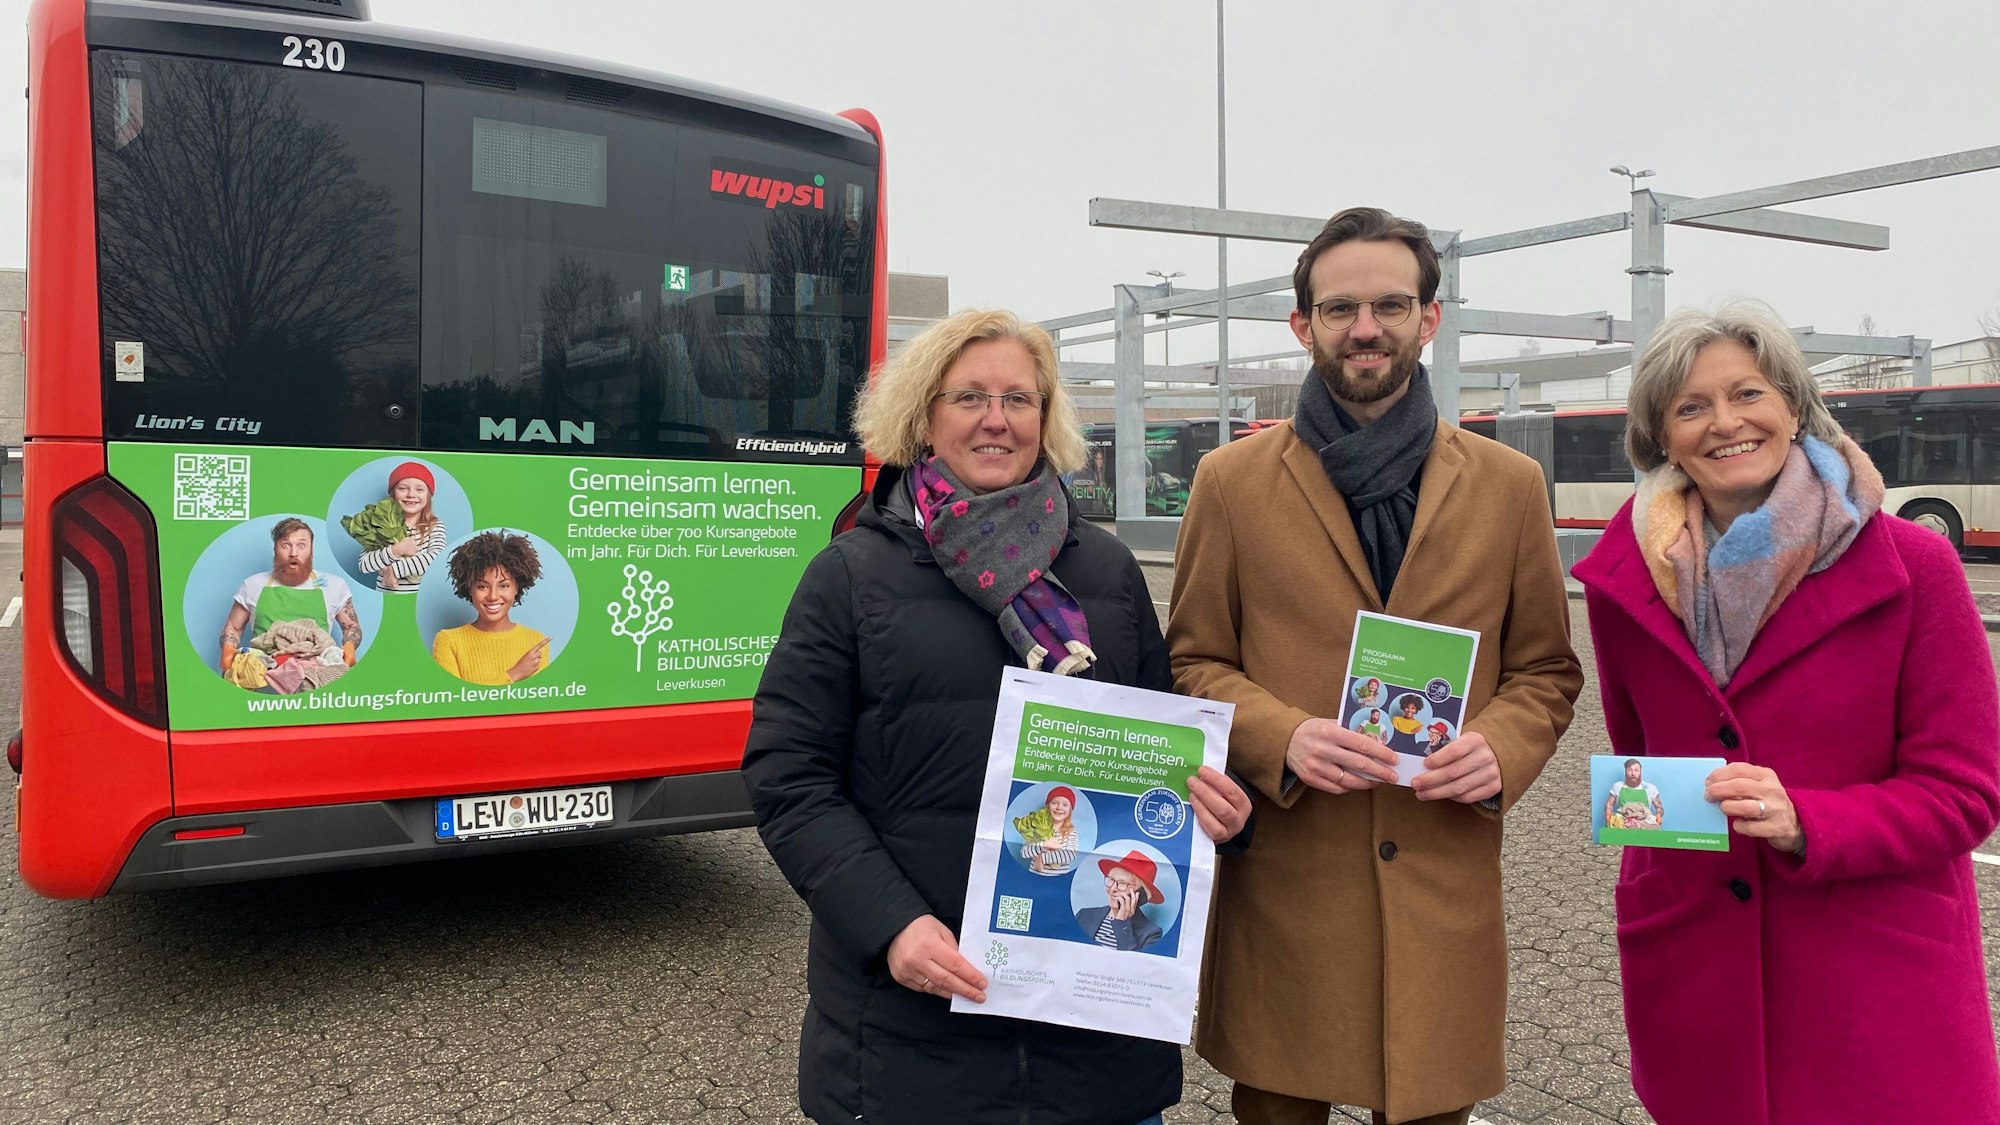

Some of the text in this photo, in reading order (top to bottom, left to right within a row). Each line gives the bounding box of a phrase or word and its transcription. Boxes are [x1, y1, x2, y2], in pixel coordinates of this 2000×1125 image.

[282, 35, 346, 72] 230
[711, 169, 825, 210] wupsi
[135, 414, 262, 435] Lion's City
[479, 416, 595, 445] MAN
[735, 437, 847, 455] EfficientHybrid
[569, 467, 797, 495] Gemeinsam lernen.
[568, 494, 822, 520] Gemeinsam wachsen.
[567, 523, 797, 541] Entdecke über 700 Kursangebote
[567, 544, 799, 561] im Jahr. Für Dich. Für Leverkusen.
[658, 635, 780, 654] KATHOLISCHES
[1362, 648, 1406, 662] PROGRAMM
[247, 681, 587, 712] www.bildungsforum-leverkusen.de
[656, 677, 726, 691] Leverkusen
[1029, 713, 1172, 749] Gemeinsam lernen.
[1024, 747, 1168, 777] Entdecke über 700 Kursangebote
[1027, 730, 1188, 768] Gemeinsam wachsen.
[1022, 759, 1167, 788] im Jahr. Für Dich. Für Leverkusen.
[442, 822, 450, 831] D
[456, 800, 506, 831] LEV
